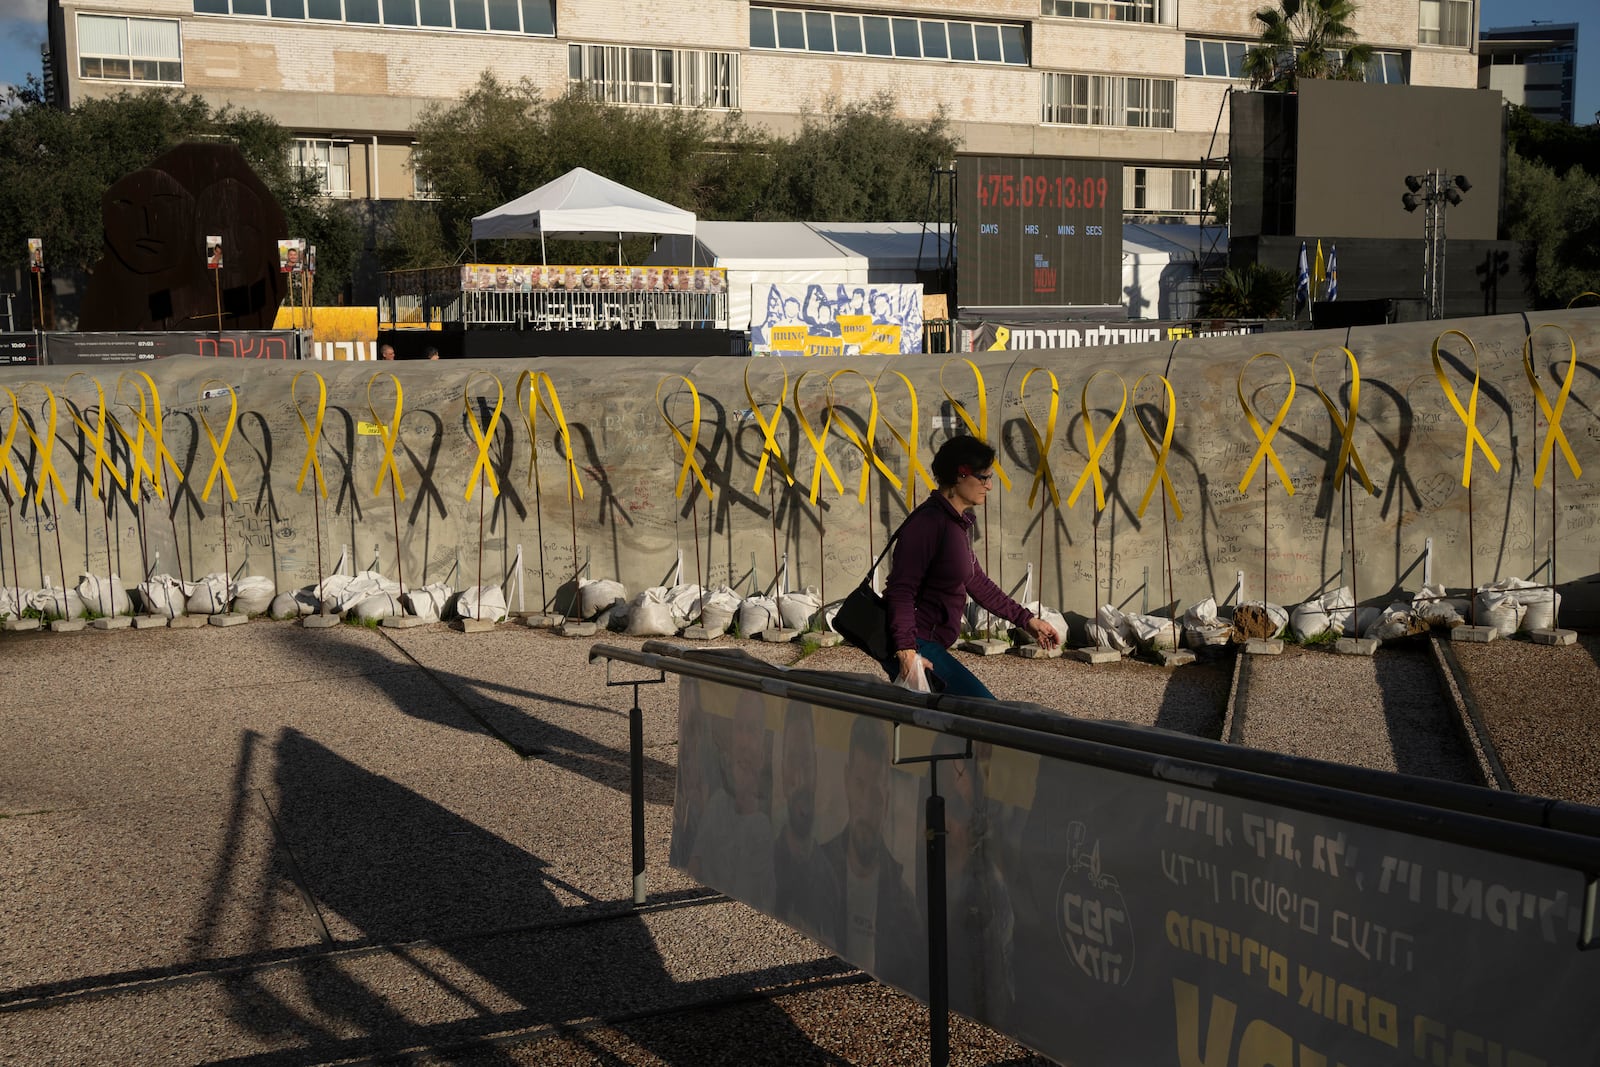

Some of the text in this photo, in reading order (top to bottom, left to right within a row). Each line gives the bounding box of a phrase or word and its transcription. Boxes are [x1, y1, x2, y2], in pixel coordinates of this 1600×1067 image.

[977, 174, 1109, 208] 475:09:13:09
[980, 223, 1103, 236] DAYS HRS MINS SECS
